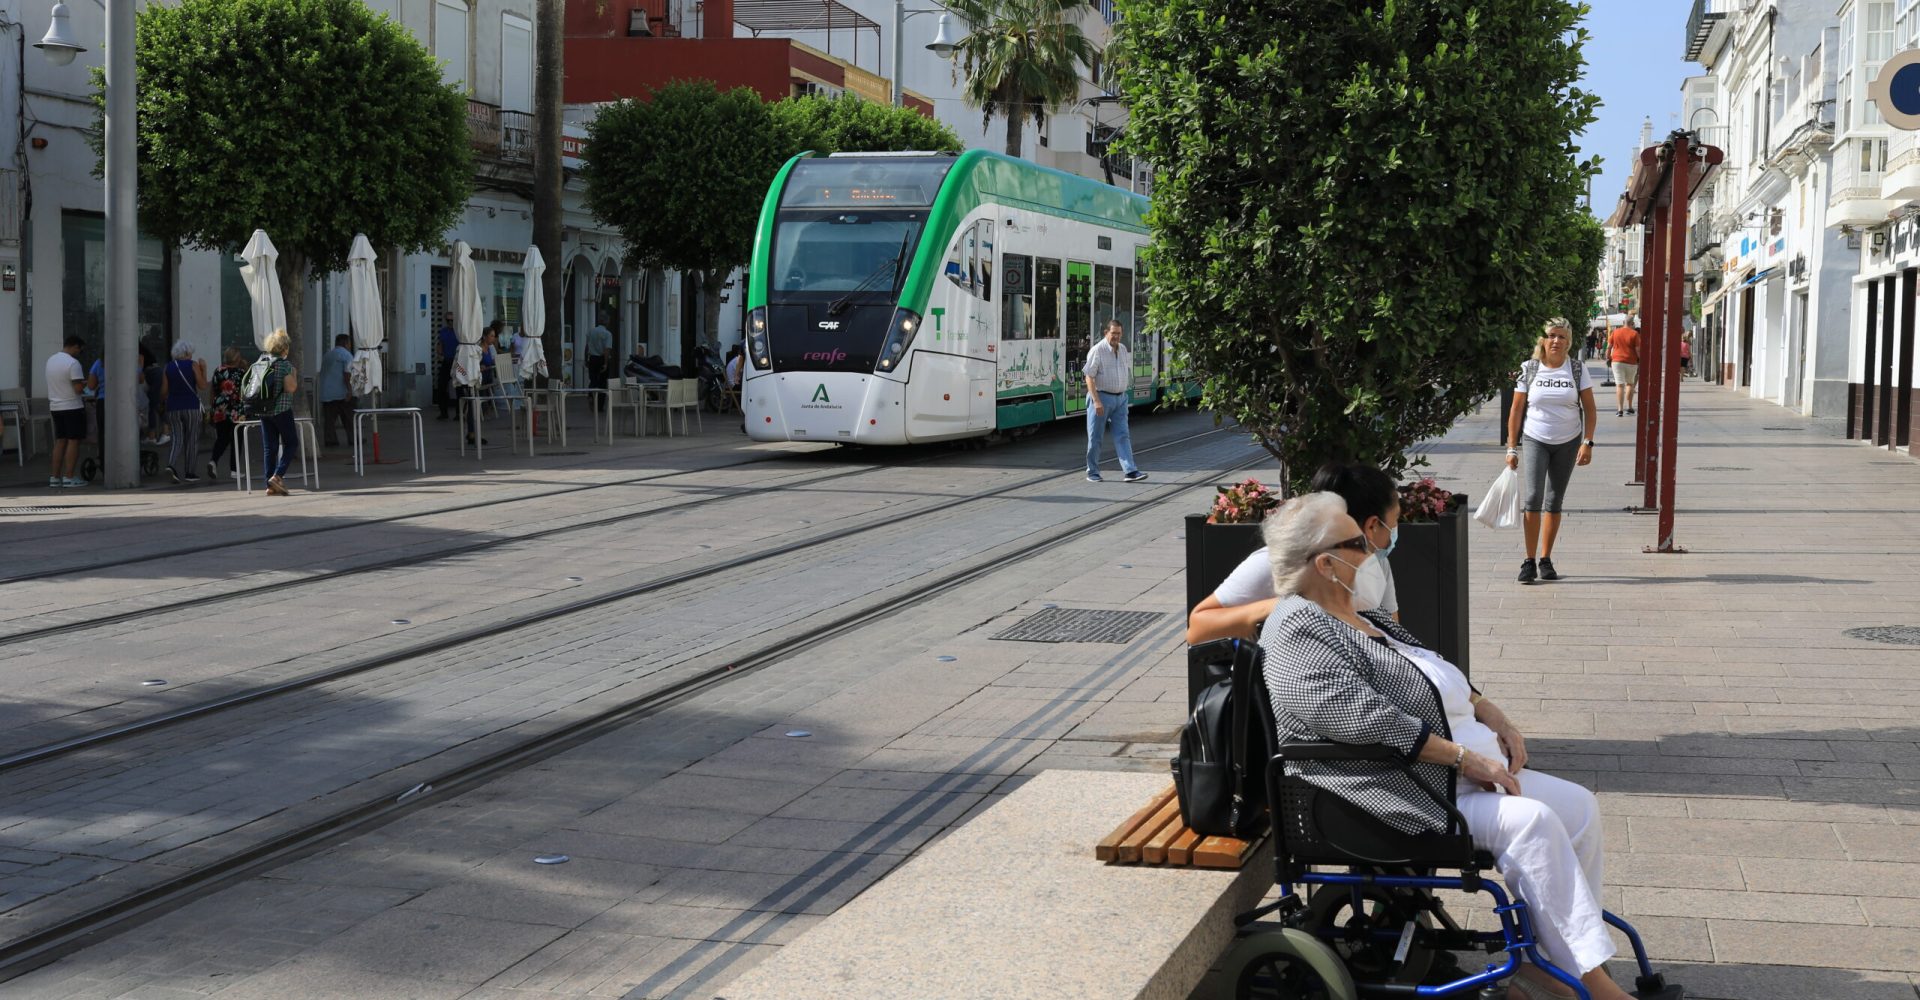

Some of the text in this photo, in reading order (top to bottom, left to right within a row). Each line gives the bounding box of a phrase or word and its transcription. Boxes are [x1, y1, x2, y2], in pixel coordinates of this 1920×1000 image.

[819, 321, 840, 330] CAF
[803, 348, 847, 366] renfe
[1536, 379, 1574, 388] adidas
